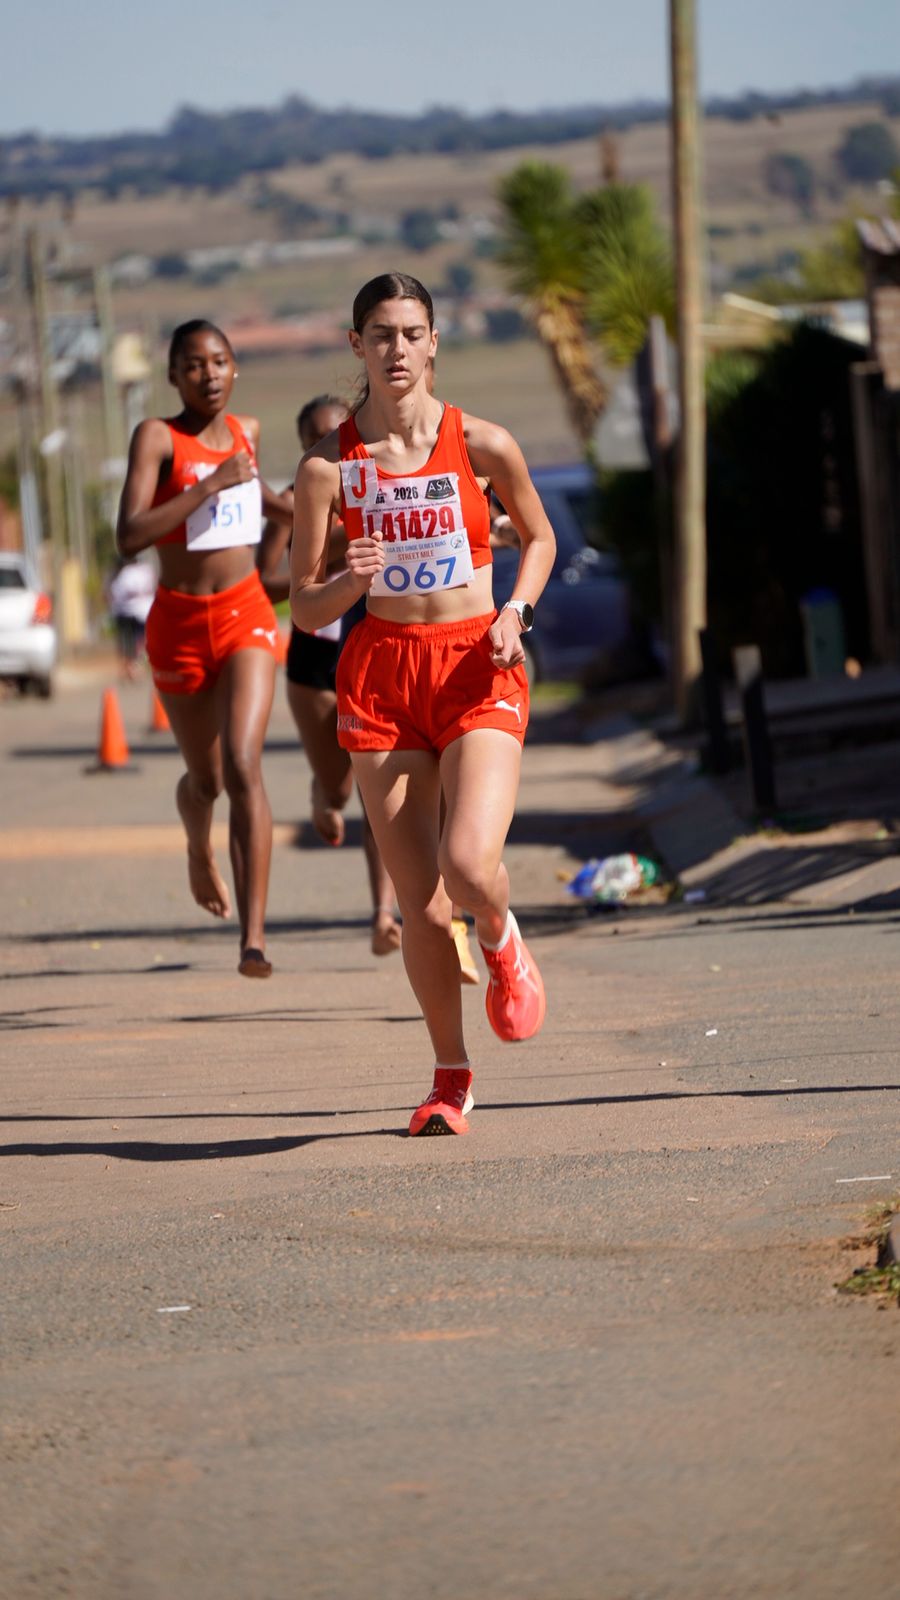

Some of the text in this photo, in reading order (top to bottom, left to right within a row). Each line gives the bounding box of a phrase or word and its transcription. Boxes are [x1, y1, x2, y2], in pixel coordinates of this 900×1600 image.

[352, 466, 367, 499] J
[428, 478, 452, 493] ASA
[393, 486, 419, 501] 2026
[209, 502, 243, 528] 151
[418, 542, 434, 550] SERIES
[398, 550, 434, 561] STREET MILE
[383, 556, 456, 592] 067
